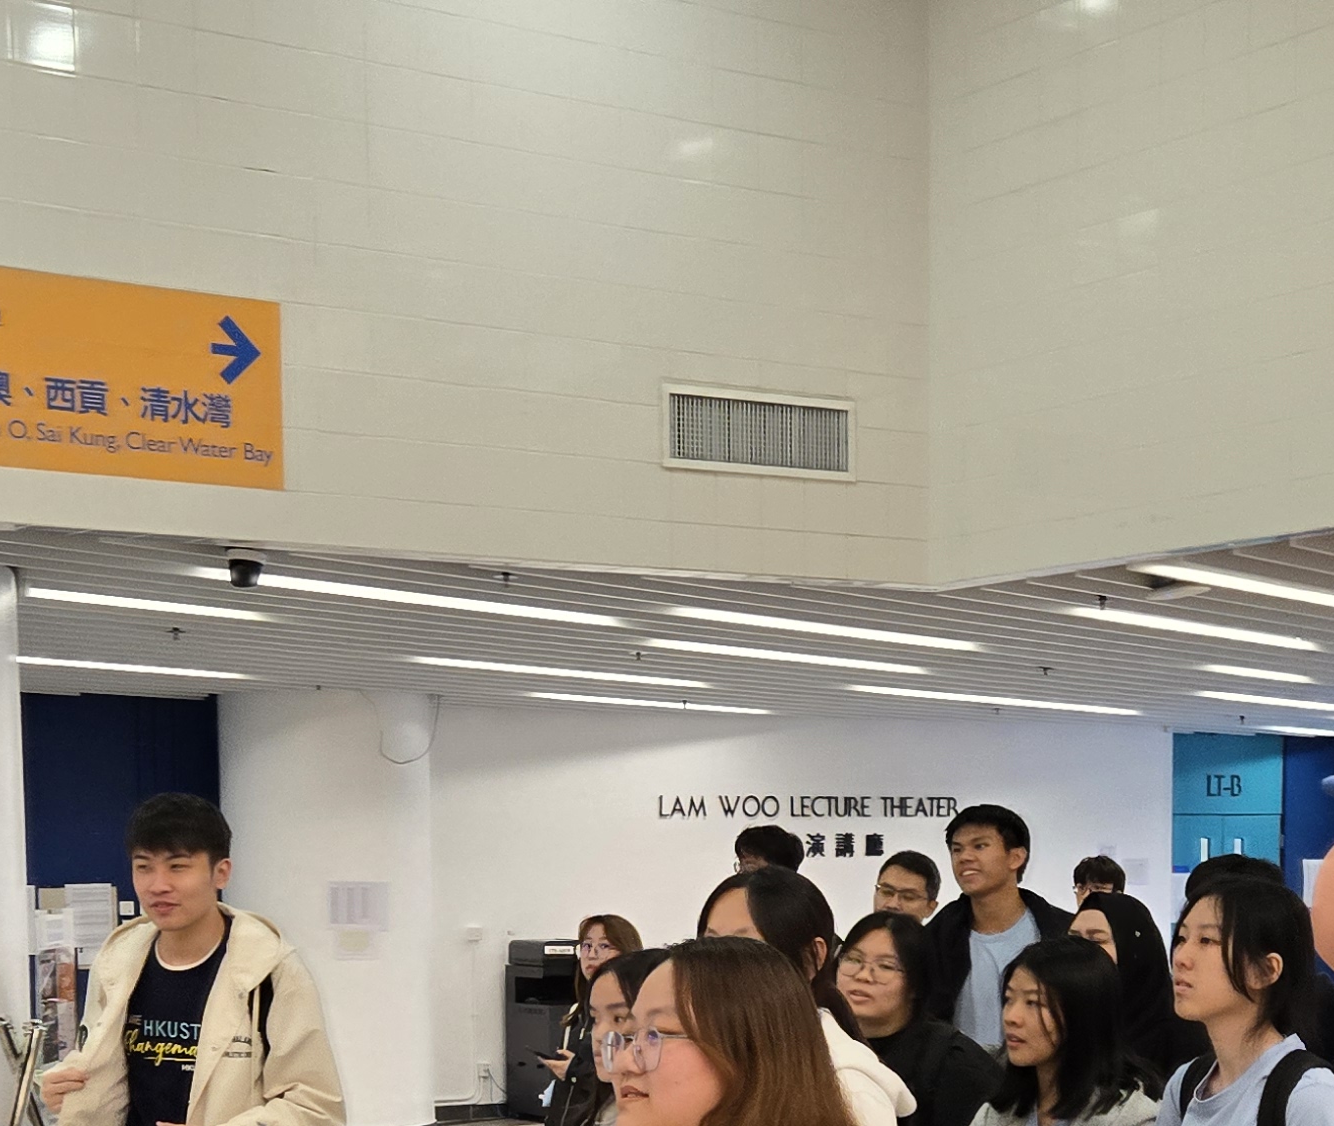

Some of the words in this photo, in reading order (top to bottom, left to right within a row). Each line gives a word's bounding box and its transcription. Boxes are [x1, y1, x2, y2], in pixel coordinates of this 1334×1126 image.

[36, 422, 63, 443] Sai
[125, 431, 174, 453] Clear
[179, 437, 237, 459] Water
[244, 443, 273, 467] Bay
[1206, 774, 1242, 797] LT-B
[658, 794, 707, 818] LAM
[718, 794, 780, 818] WOO
[789, 795, 872, 818] LECTURE
[880, 795, 959, 818] THEATER
[143, 1020, 201, 1040] HKUST
[127, 1028, 198, 1066] Changema
